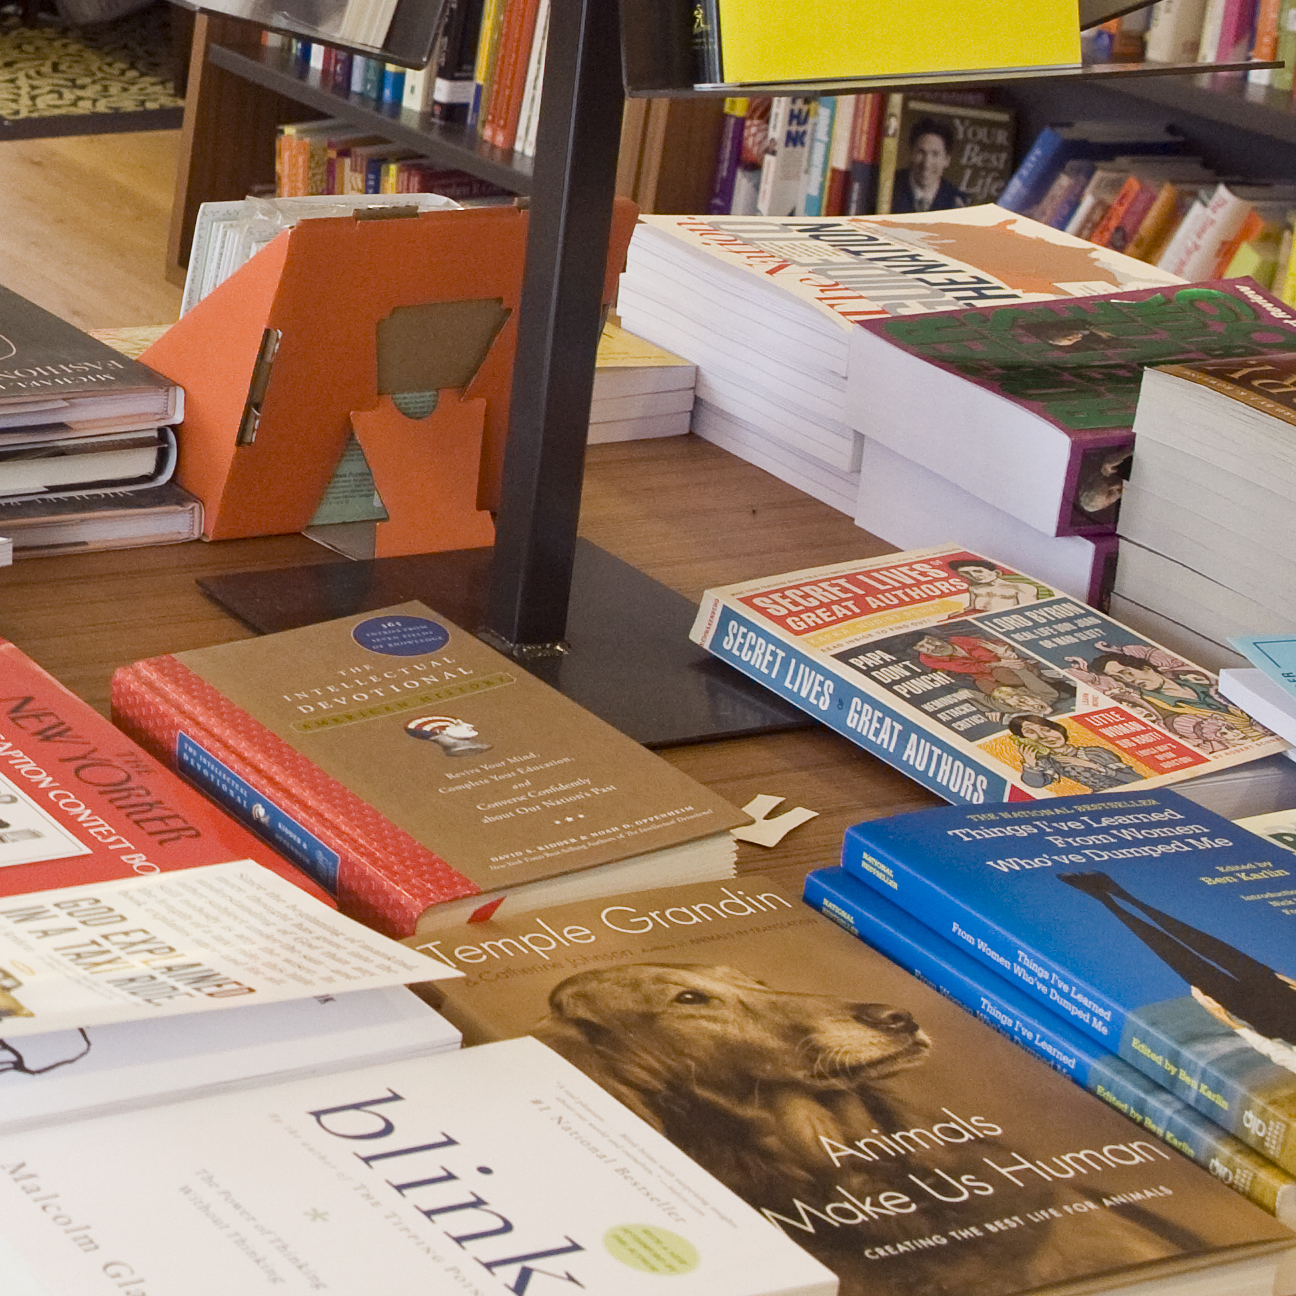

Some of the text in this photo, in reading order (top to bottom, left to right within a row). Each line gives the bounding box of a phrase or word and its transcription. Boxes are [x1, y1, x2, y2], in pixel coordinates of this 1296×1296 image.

[953, 118, 1008, 146] YOUR
[961, 143, 1008, 168] Best
[960, 169, 1006, 196] Life
[752, 561, 949, 617] SECRET LIVES
[785, 578, 970, 636] GREAT AUTHORS
[984, 602, 1086, 633] LORD BYRON
[283, 656, 458, 703] INTELLECTUAL
[337, 664, 374, 677] THE
[849, 649, 896, 671] PAPA
[872, 661, 923, 685] DON'T
[296, 667, 475, 715] DEVOTIONAL
[893, 672, 955, 697] PUNCH!
[722, 620, 988, 805] SECRET LIVES GREAT AUTHORS
[1085, 710, 1125, 727] LITTLE
[119, 749, 157, 777] THE
[63, 741, 202, 848] YORKER
[46, 786, 135, 863] CONTEST
[947, 808, 1184, 843] Things I've Learned
[1050, 821, 1210, 849] From Women
[986, 835, 1232, 875] Who've Dumped Me
[1201, 867, 1290, 887] Ben Karlin
[1216, 860, 1273, 875] Edited by
[53, 897, 256, 999] GOD EXPLAINED
[416, 887, 793, 969] Temple Grandin
[0, 904, 195, 1007] IN A TAXI RIDE
[952, 921, 1109, 1036] From Women Who've Dumped Me
[1017, 950, 1111, 1021] Things I've Learned
[819, 1107, 1004, 1168] Animals
[307, 1087, 586, 1296] blink
[552, 1114, 687, 1224] National Bestseller
[760, 1139, 1170, 1235] Make Us Human
[1, 1161, 100, 1254] Malcolm
[864, 1185, 1172, 1261] CREATING THE BEST LIFE FOR ANIMALS
